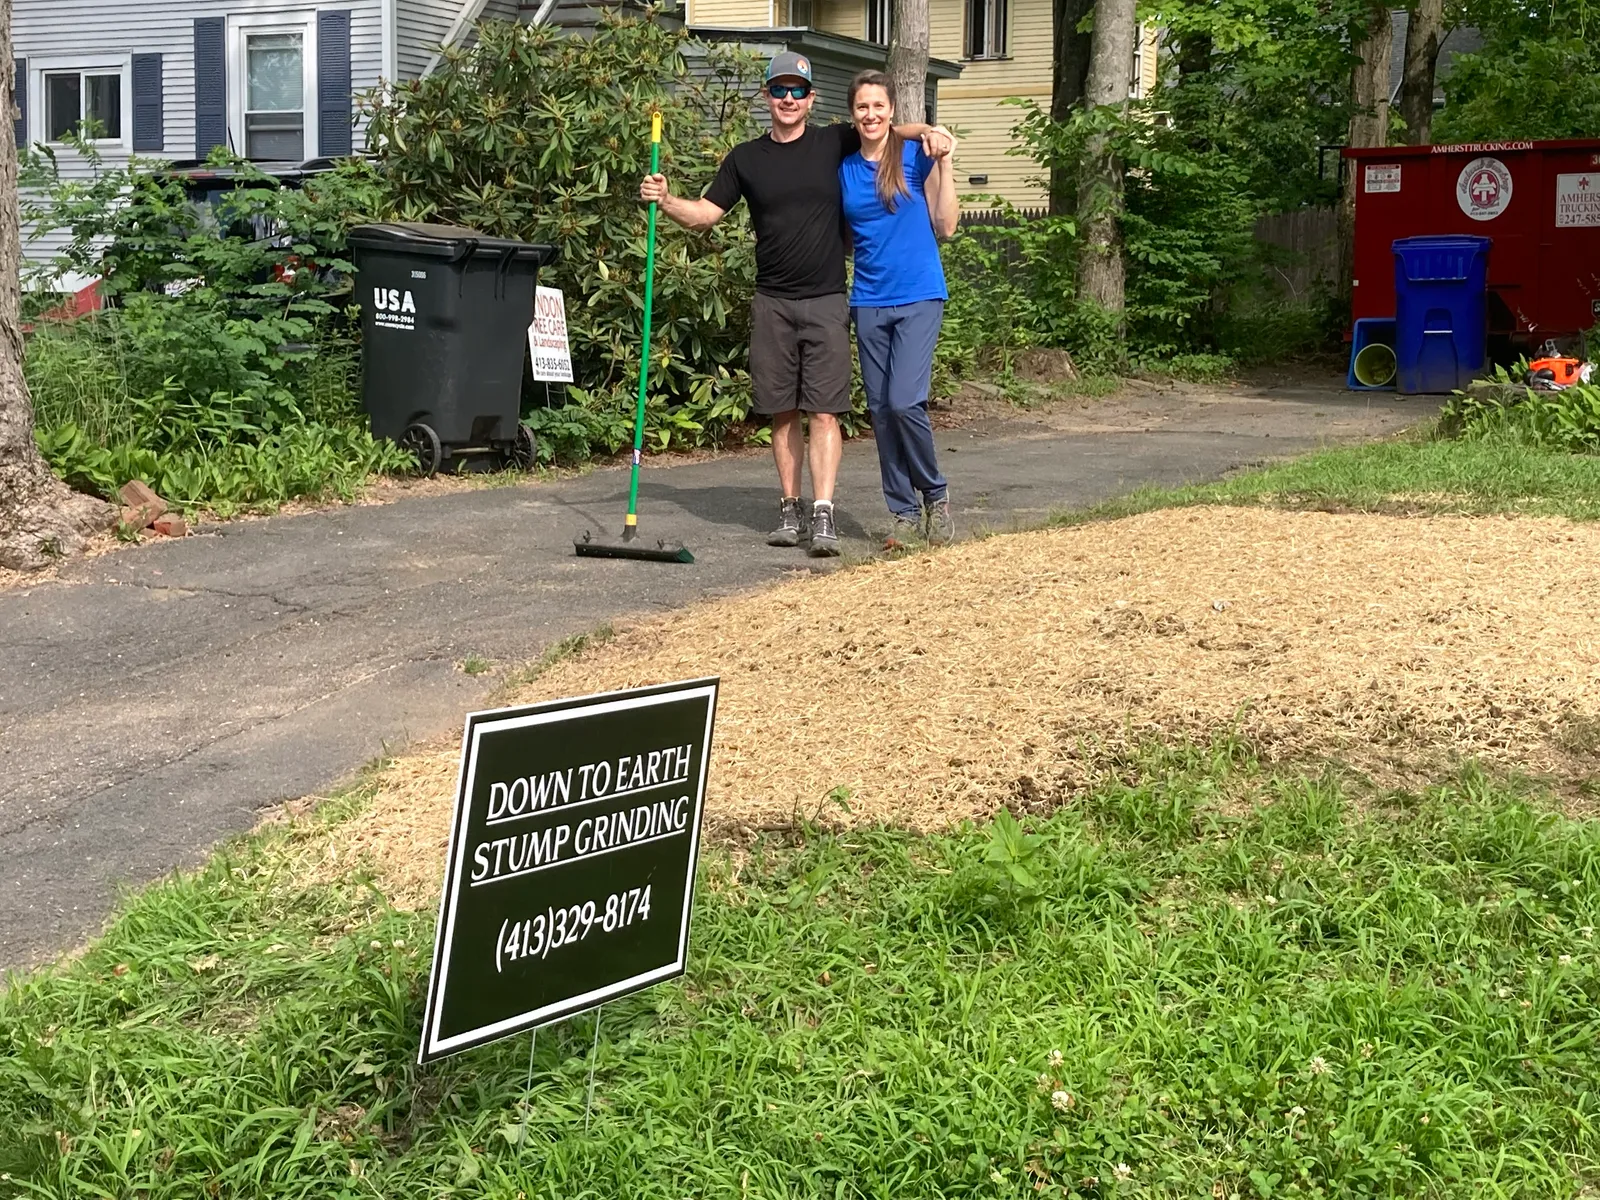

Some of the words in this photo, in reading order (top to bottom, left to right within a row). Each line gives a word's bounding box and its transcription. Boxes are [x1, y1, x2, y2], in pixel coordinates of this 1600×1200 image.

[1431, 142, 1533, 153] AMHERSTTRUCKING.COM
[373, 287, 416, 313] USA
[548, 319, 566, 337] CARE
[539, 336, 567, 353] Landscaping
[486, 768, 572, 820] DOWN
[577, 761, 611, 800] TO
[614, 744, 692, 790] EARTH
[471, 825, 571, 881] STUMP
[574, 796, 689, 855] GRINDING
[495, 884, 652, 973] (413)329-8174
